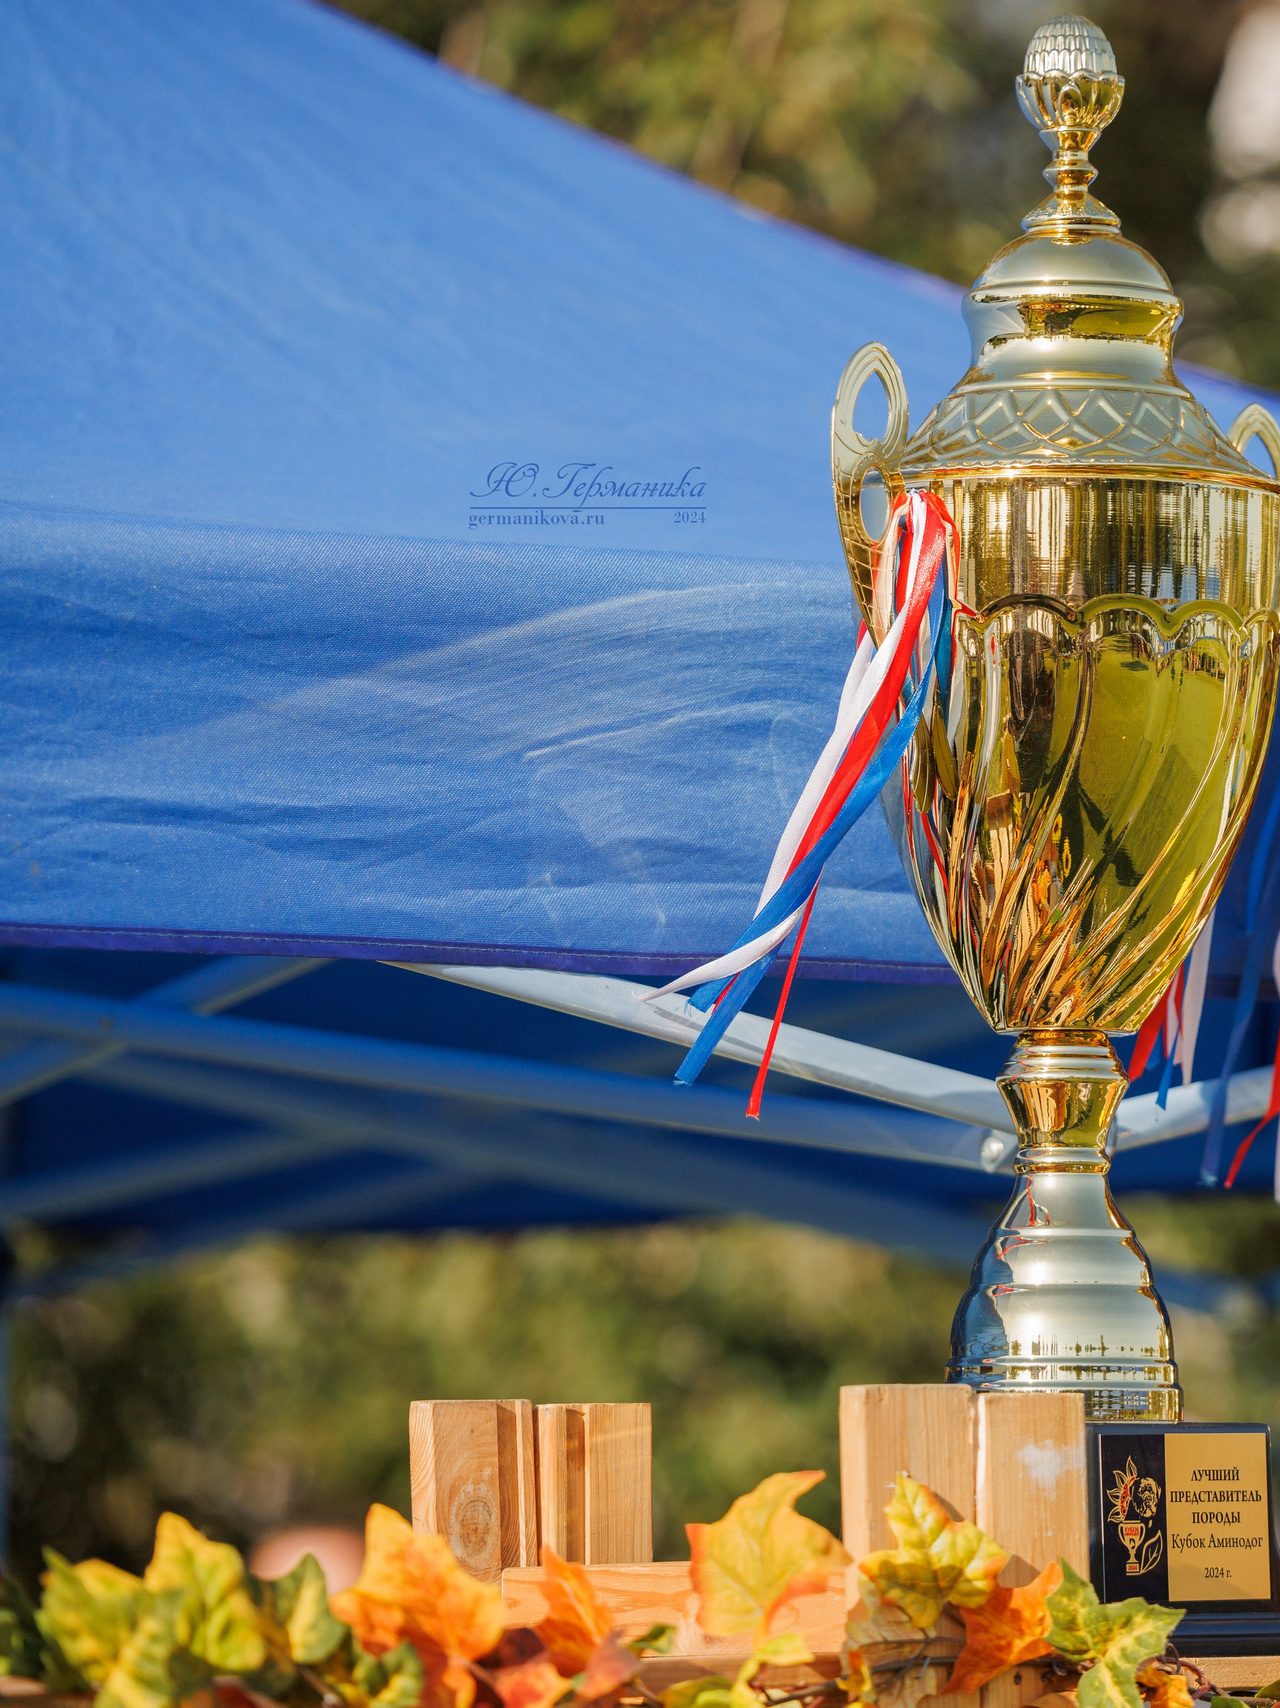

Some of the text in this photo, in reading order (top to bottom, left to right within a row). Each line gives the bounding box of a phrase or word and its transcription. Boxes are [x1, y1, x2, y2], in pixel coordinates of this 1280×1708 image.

[1190, 1466, 1240, 1482] ЛУЧШИЙ
[1169, 1489, 1262, 1505] ПРЕДСТАВИТЕЛЬ
[1191, 1511, 1241, 1526] ПОРОДЫ
[1171, 1532, 1264, 1554] Кубок Аминодог
[1204, 1567, 1225, 1578] 2024
